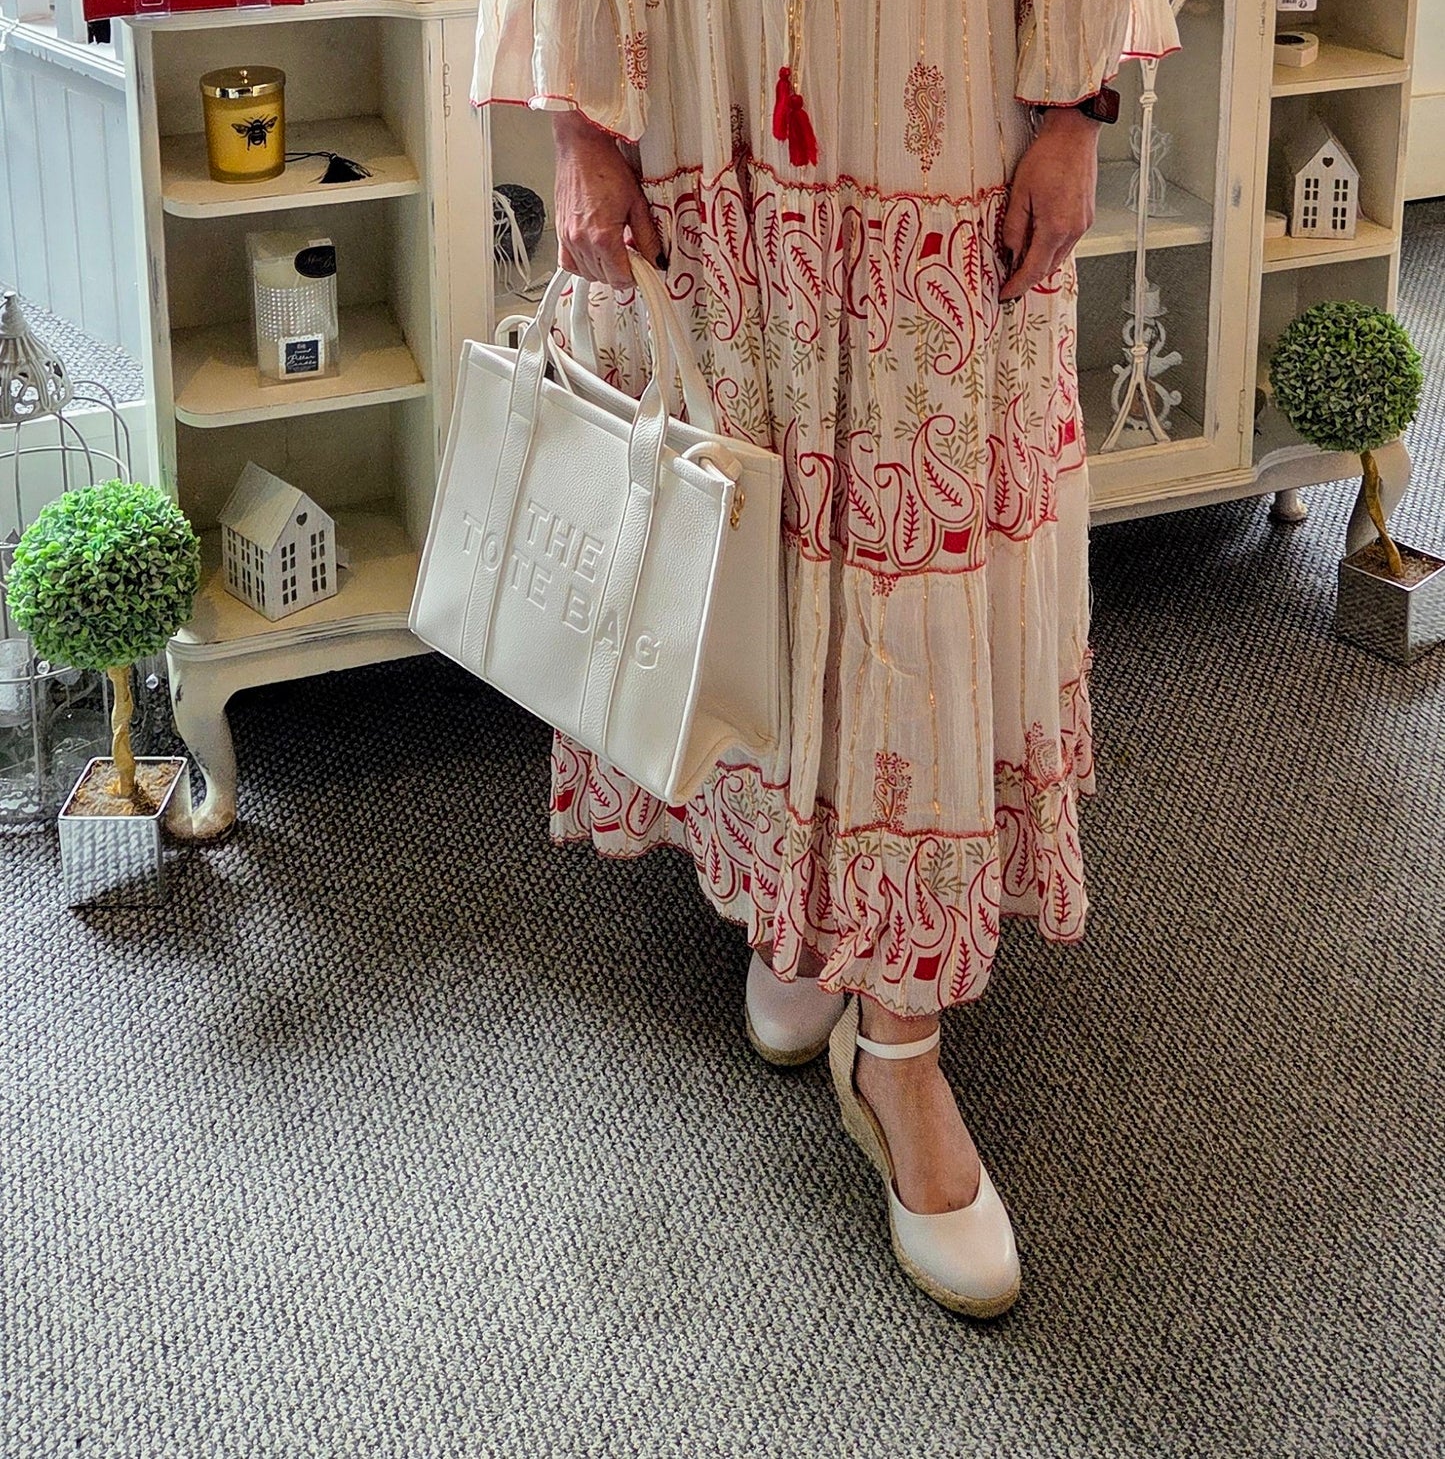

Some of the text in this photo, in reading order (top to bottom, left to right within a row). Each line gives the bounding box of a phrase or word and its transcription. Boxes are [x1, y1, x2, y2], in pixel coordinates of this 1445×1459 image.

[463, 512, 661, 669] TOTE BAG
[528, 499, 604, 583] THE
